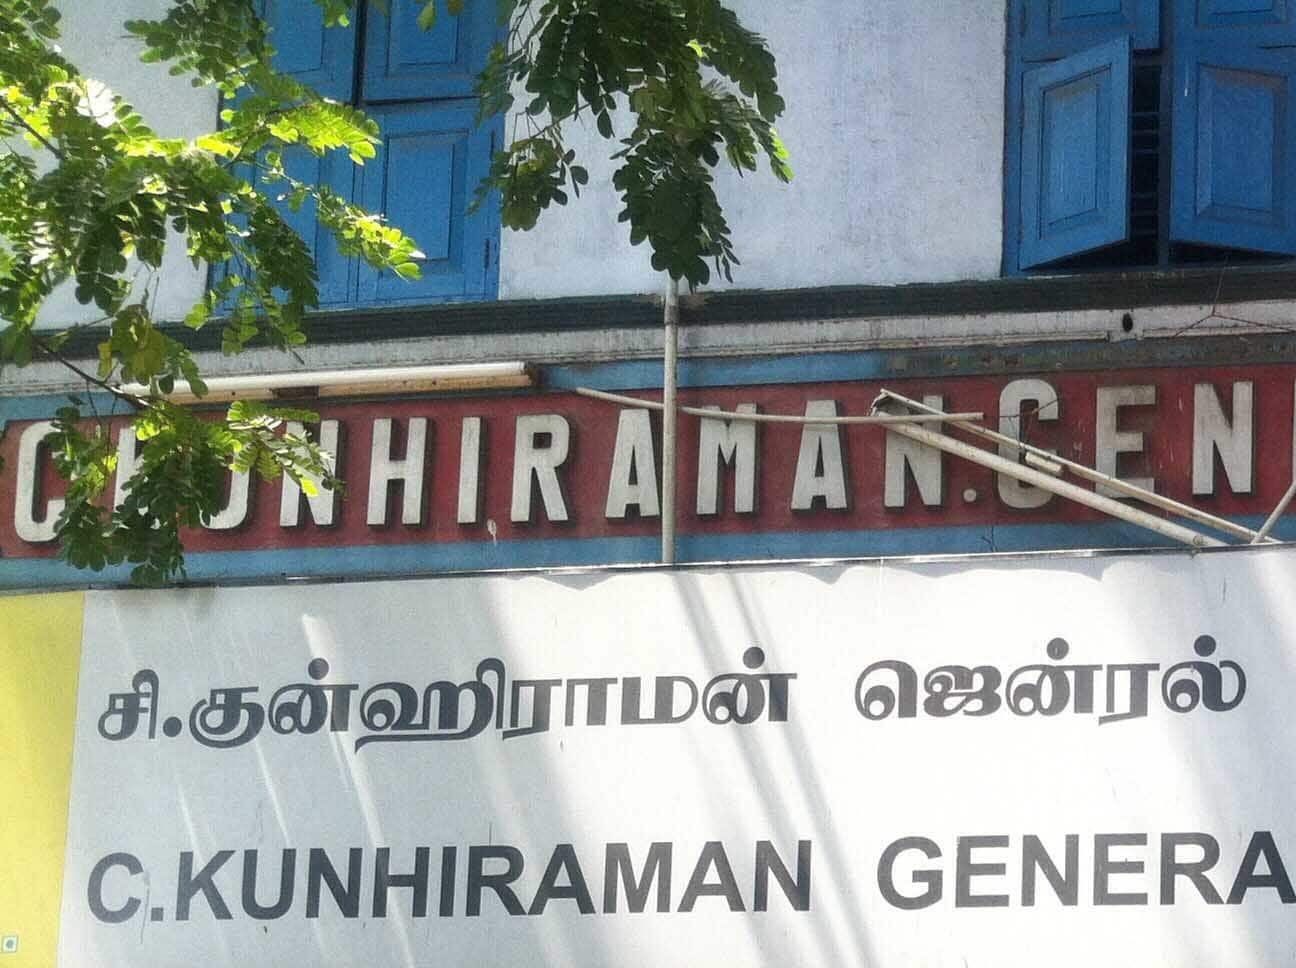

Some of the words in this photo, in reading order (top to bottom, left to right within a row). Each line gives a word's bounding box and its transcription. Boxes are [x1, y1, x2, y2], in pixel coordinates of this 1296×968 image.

[97, 646, 798, 752] சி.குன்ஹிராமன்
[854, 633, 1248, 727] ஜென்ரல்
[86, 840, 812, 925] C.KUNHIRAMAN
